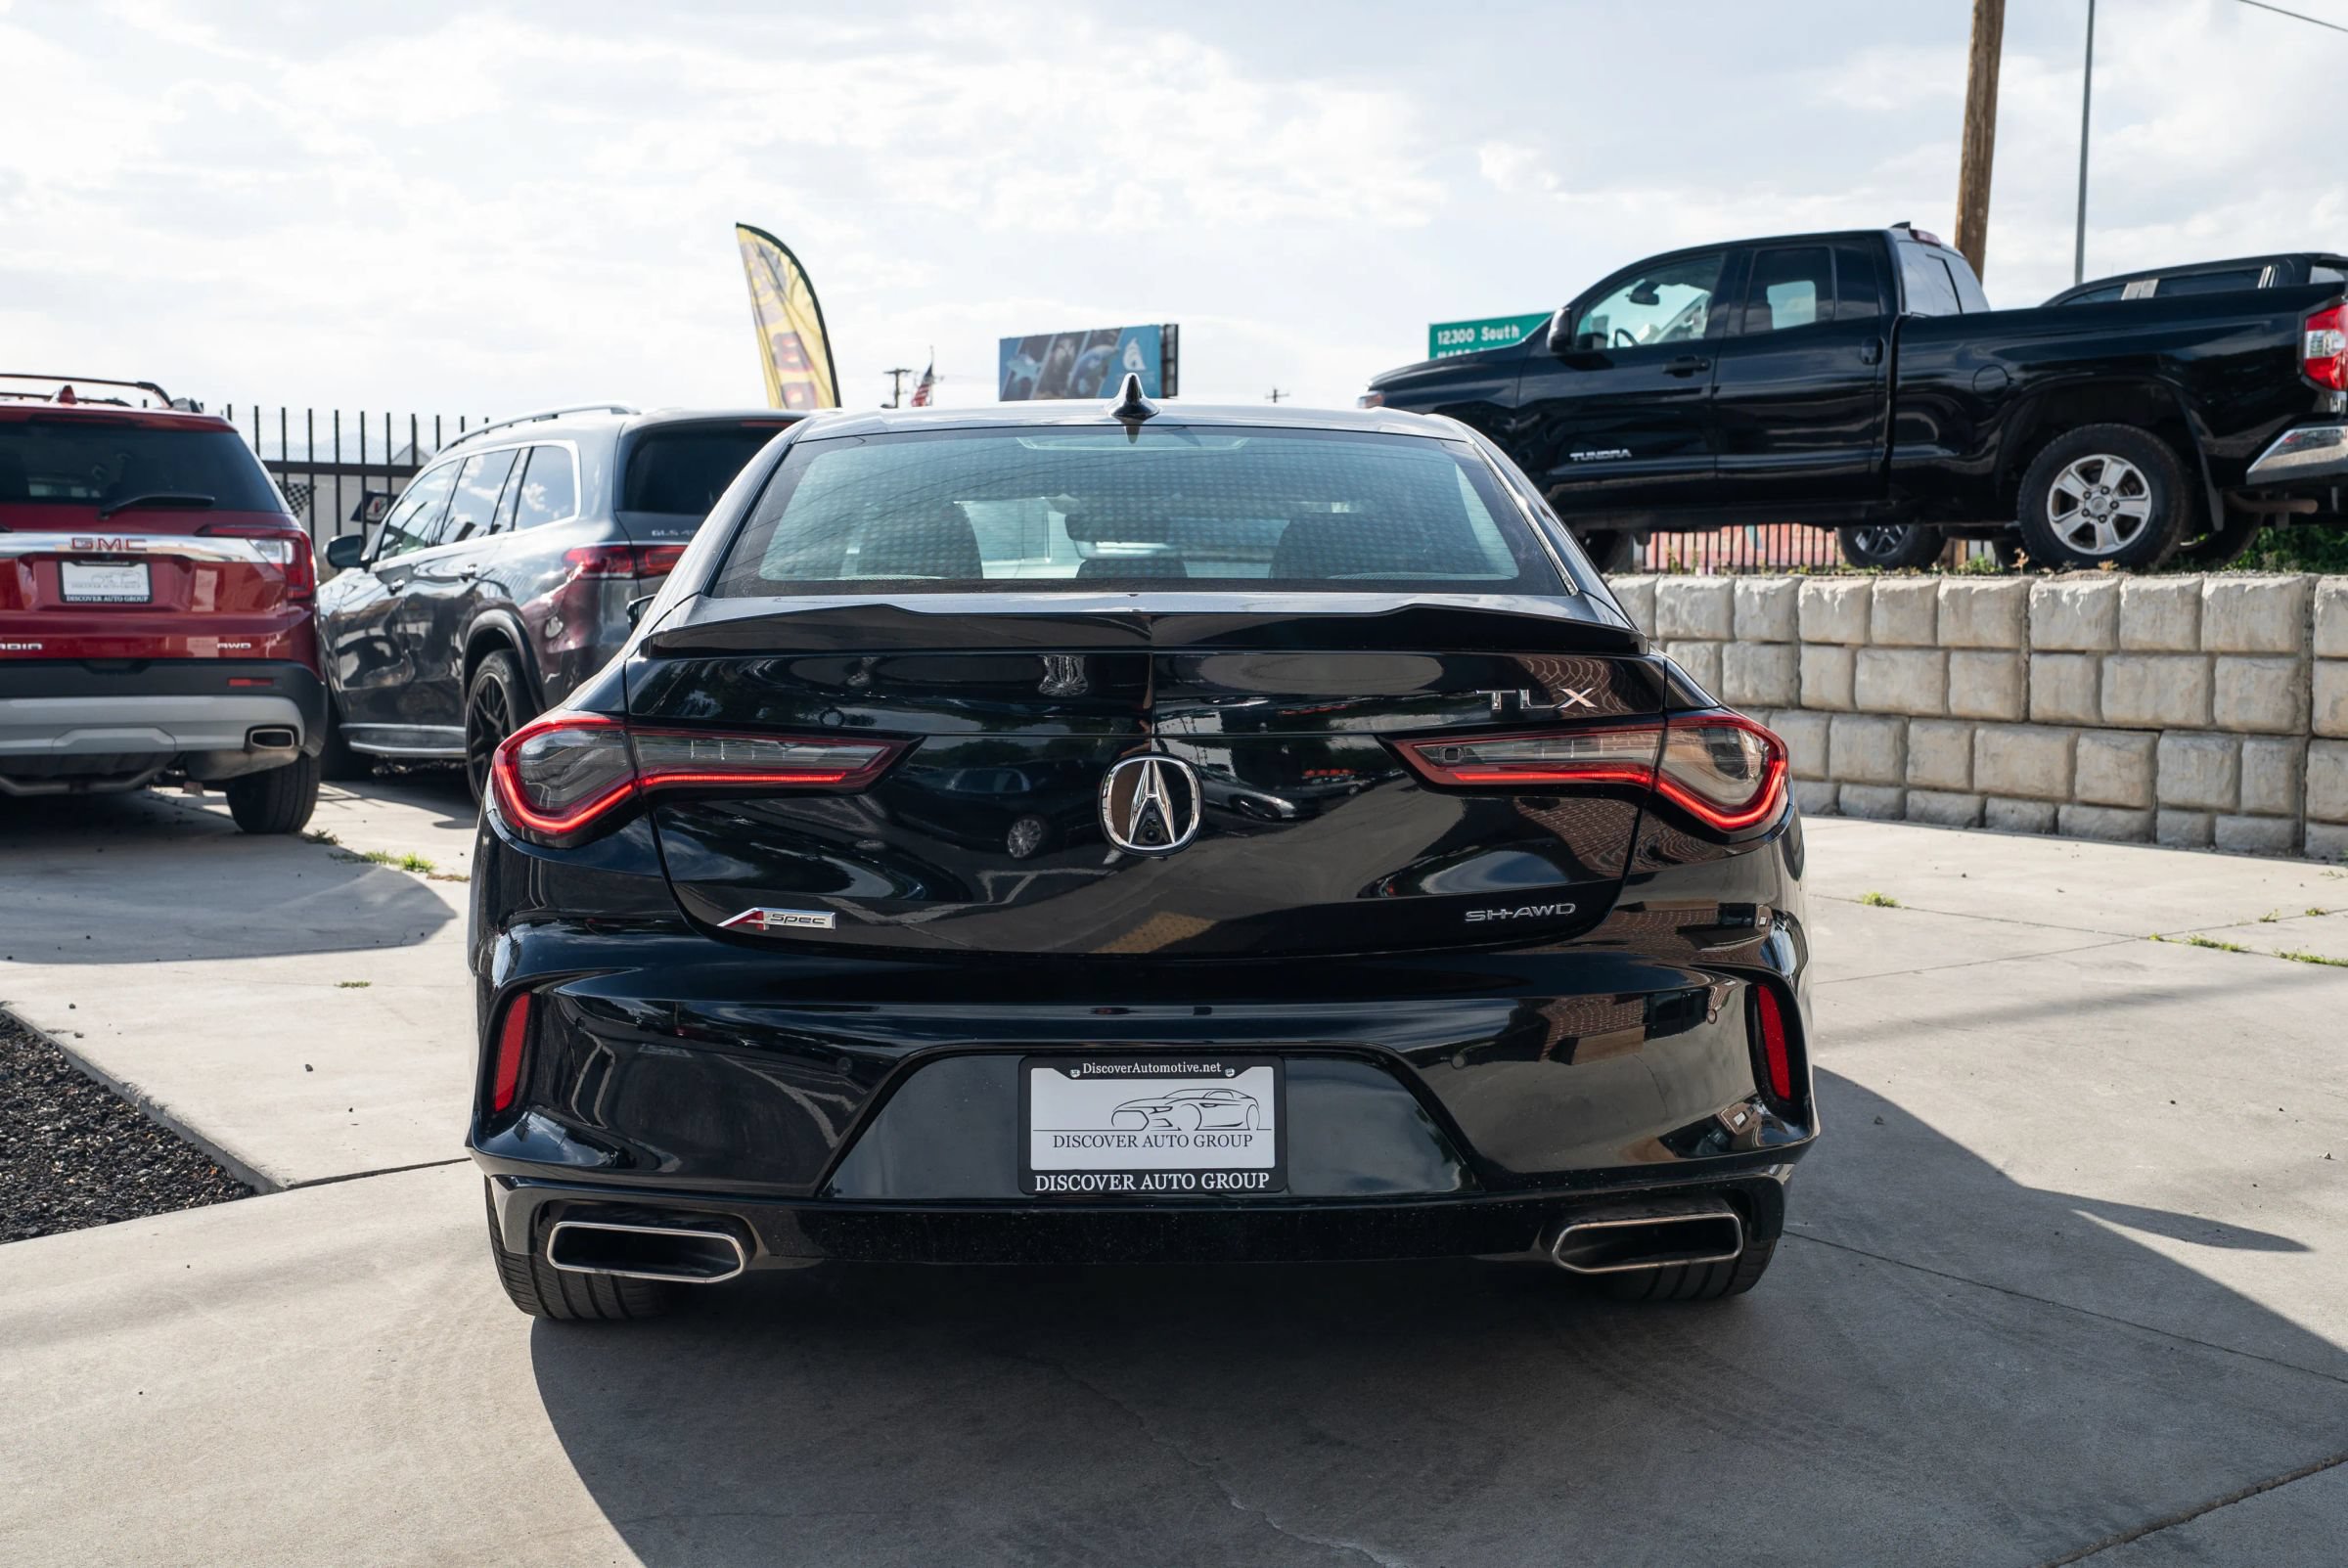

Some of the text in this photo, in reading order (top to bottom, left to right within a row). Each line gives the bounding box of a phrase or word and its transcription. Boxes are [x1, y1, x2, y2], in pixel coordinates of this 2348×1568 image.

[1437, 325, 1519, 345] 12300 South
[1569, 448, 1632, 462] TUNDRA
[70, 537, 148, 552] GMC
[1475, 688, 1598, 710] TLX
[1465, 902, 1576, 921] SH-AWD
[1082, 1061, 1222, 1075] DiscoverAutomotive.net
[1053, 1134, 1253, 1149] DISCOVER AUTO GROUP
[1035, 1172, 1270, 1191] DISCOVER AUTO GROUP
